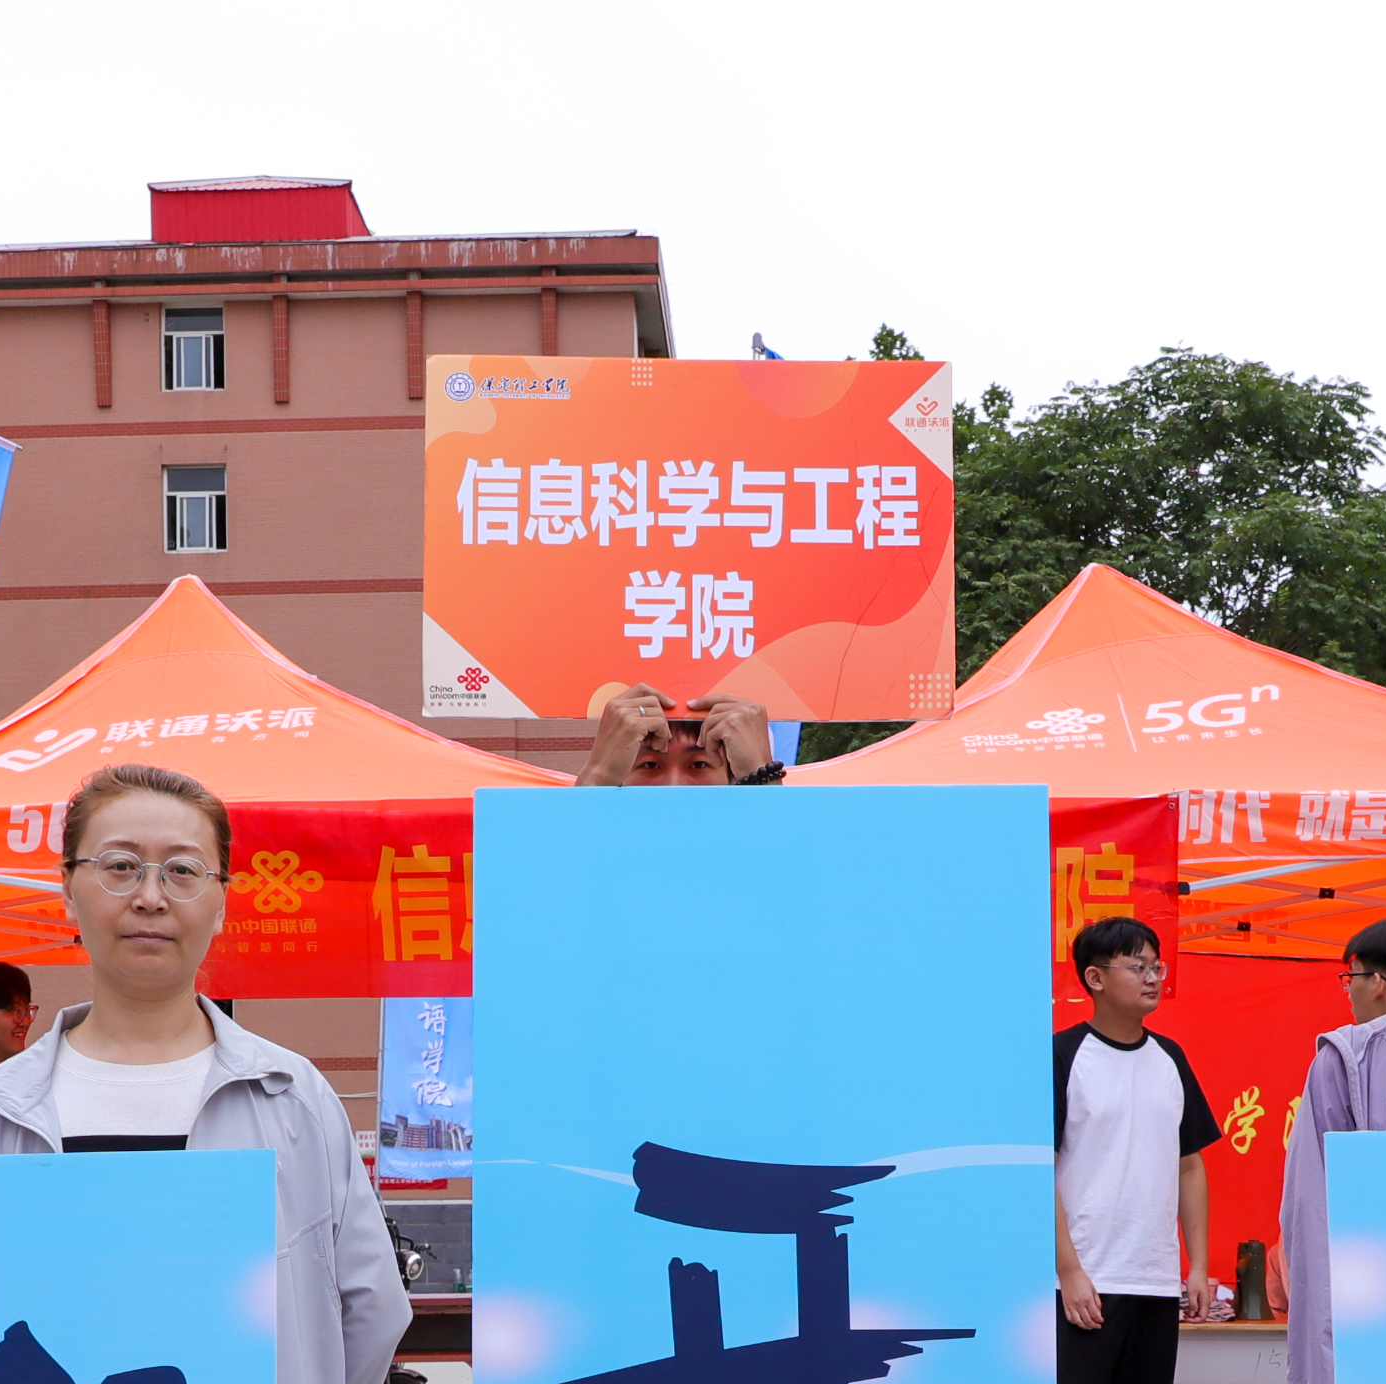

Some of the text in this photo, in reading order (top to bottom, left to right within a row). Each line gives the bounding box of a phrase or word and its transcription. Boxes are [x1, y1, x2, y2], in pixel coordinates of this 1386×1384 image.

[905, 417, 950, 427] 联通沃派
[456, 457, 921, 550] 信息科学与工程
[623, 570, 755, 660] 学院
[103, 707, 317, 743] 联通沃派
[961, 733, 1019, 741] China
[1152, 727, 1263, 743] 让未来生长
[964, 733, 1104, 747] unicom 中国联通
[372, 844, 473, 962] 信
[242, 918, 317, 934] 中国联通
[411, 1001, 454, 1107] 语学院
